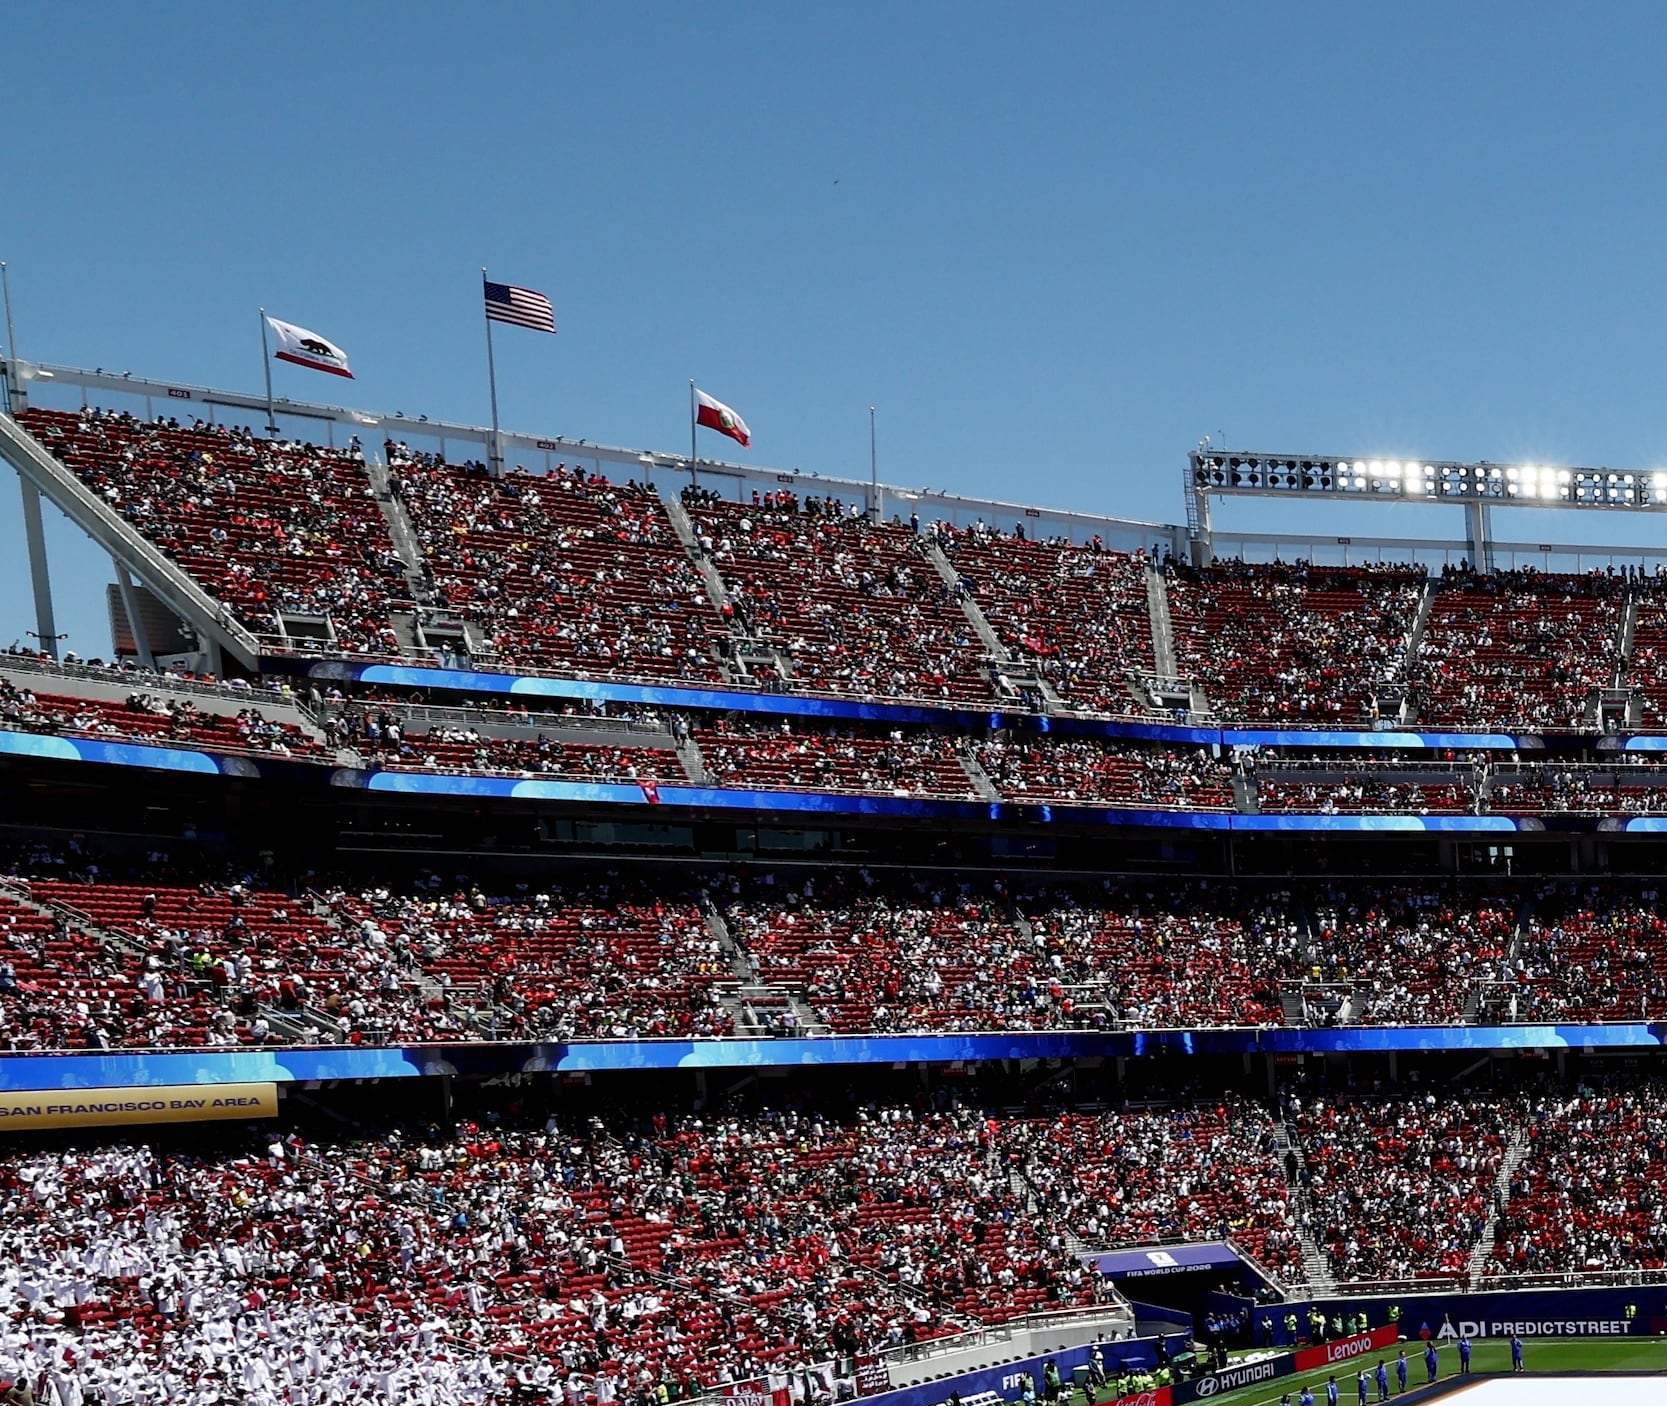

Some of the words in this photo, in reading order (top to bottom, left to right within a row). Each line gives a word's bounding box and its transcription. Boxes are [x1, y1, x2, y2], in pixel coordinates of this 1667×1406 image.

[170, 390, 188, 398] 401
[0, 1106, 42, 1118] SAN
[47, 1100, 165, 1116] FRANCISCO
[170, 1098, 206, 1110] BAY
[211, 1096, 261, 1108] AREA
[1143, 1268, 1171, 1277] WORLD
[1171, 1266, 1186, 1274] CUP
[1186, 1263, 1212, 1272] 2026
[1437, 1320, 1486, 1339] ADI
[1491, 1319, 1632, 1336] PREDICTSTREET
[1327, 1337, 1372, 1362] Lenovo
[1002, 1374, 1022, 1390] FIF
[1220, 1363, 1275, 1387] HYUNDAI
